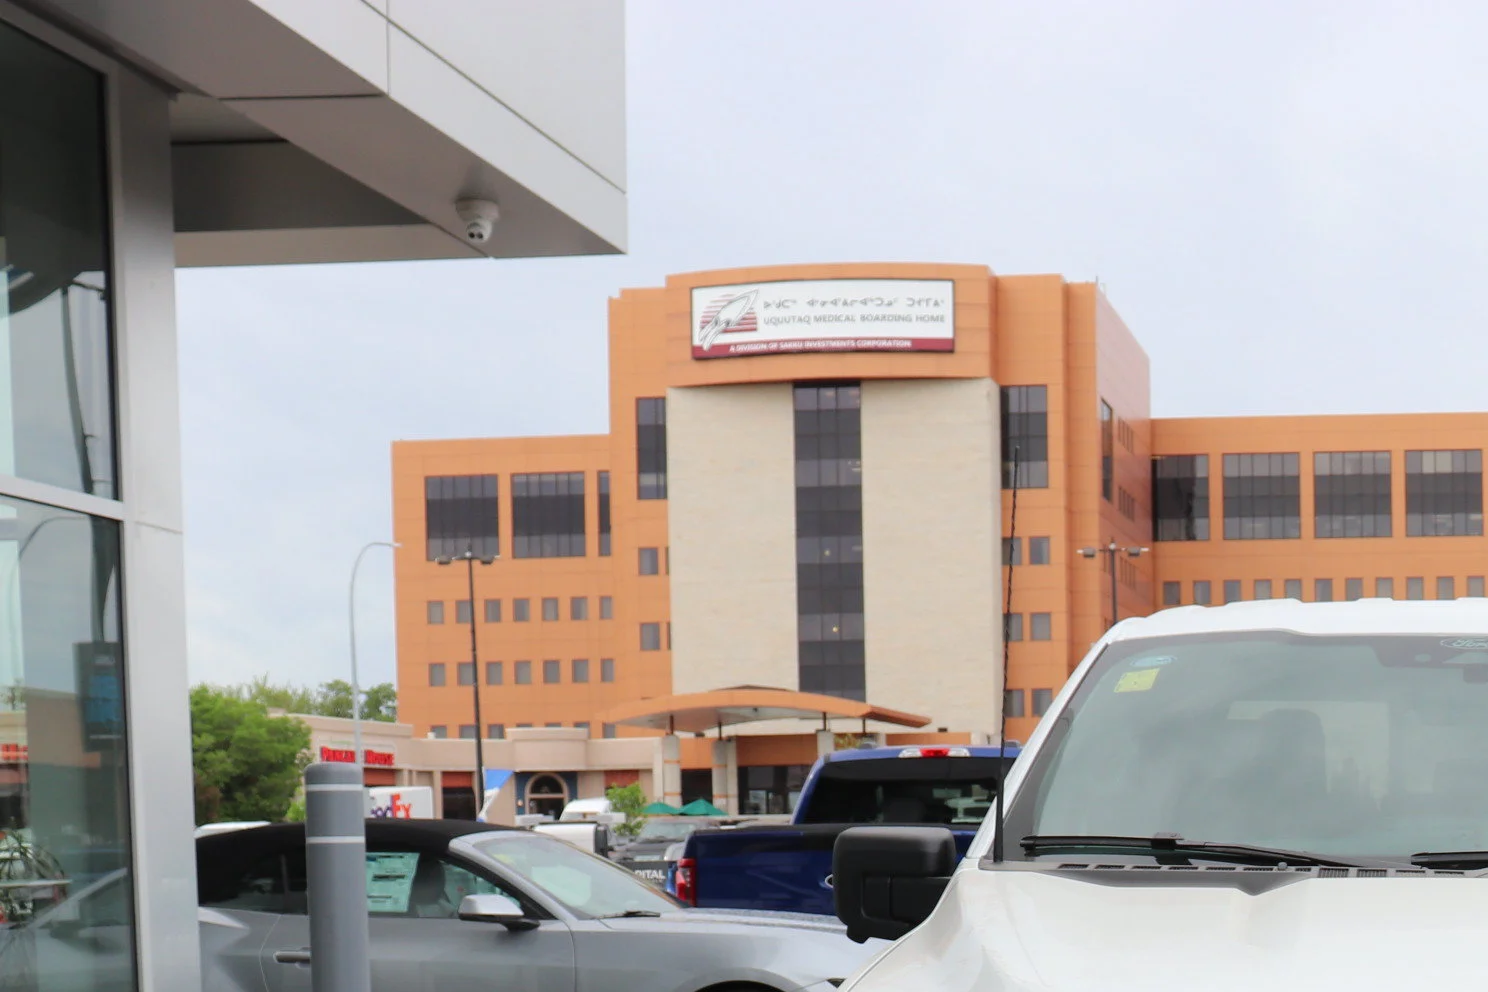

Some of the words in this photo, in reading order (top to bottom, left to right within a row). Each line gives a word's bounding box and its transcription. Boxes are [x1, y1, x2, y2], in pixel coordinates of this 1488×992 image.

[813, 313, 856, 322] MEDICAL
[860, 313, 912, 322] BOARDING
[915, 313, 945, 322] HOME
